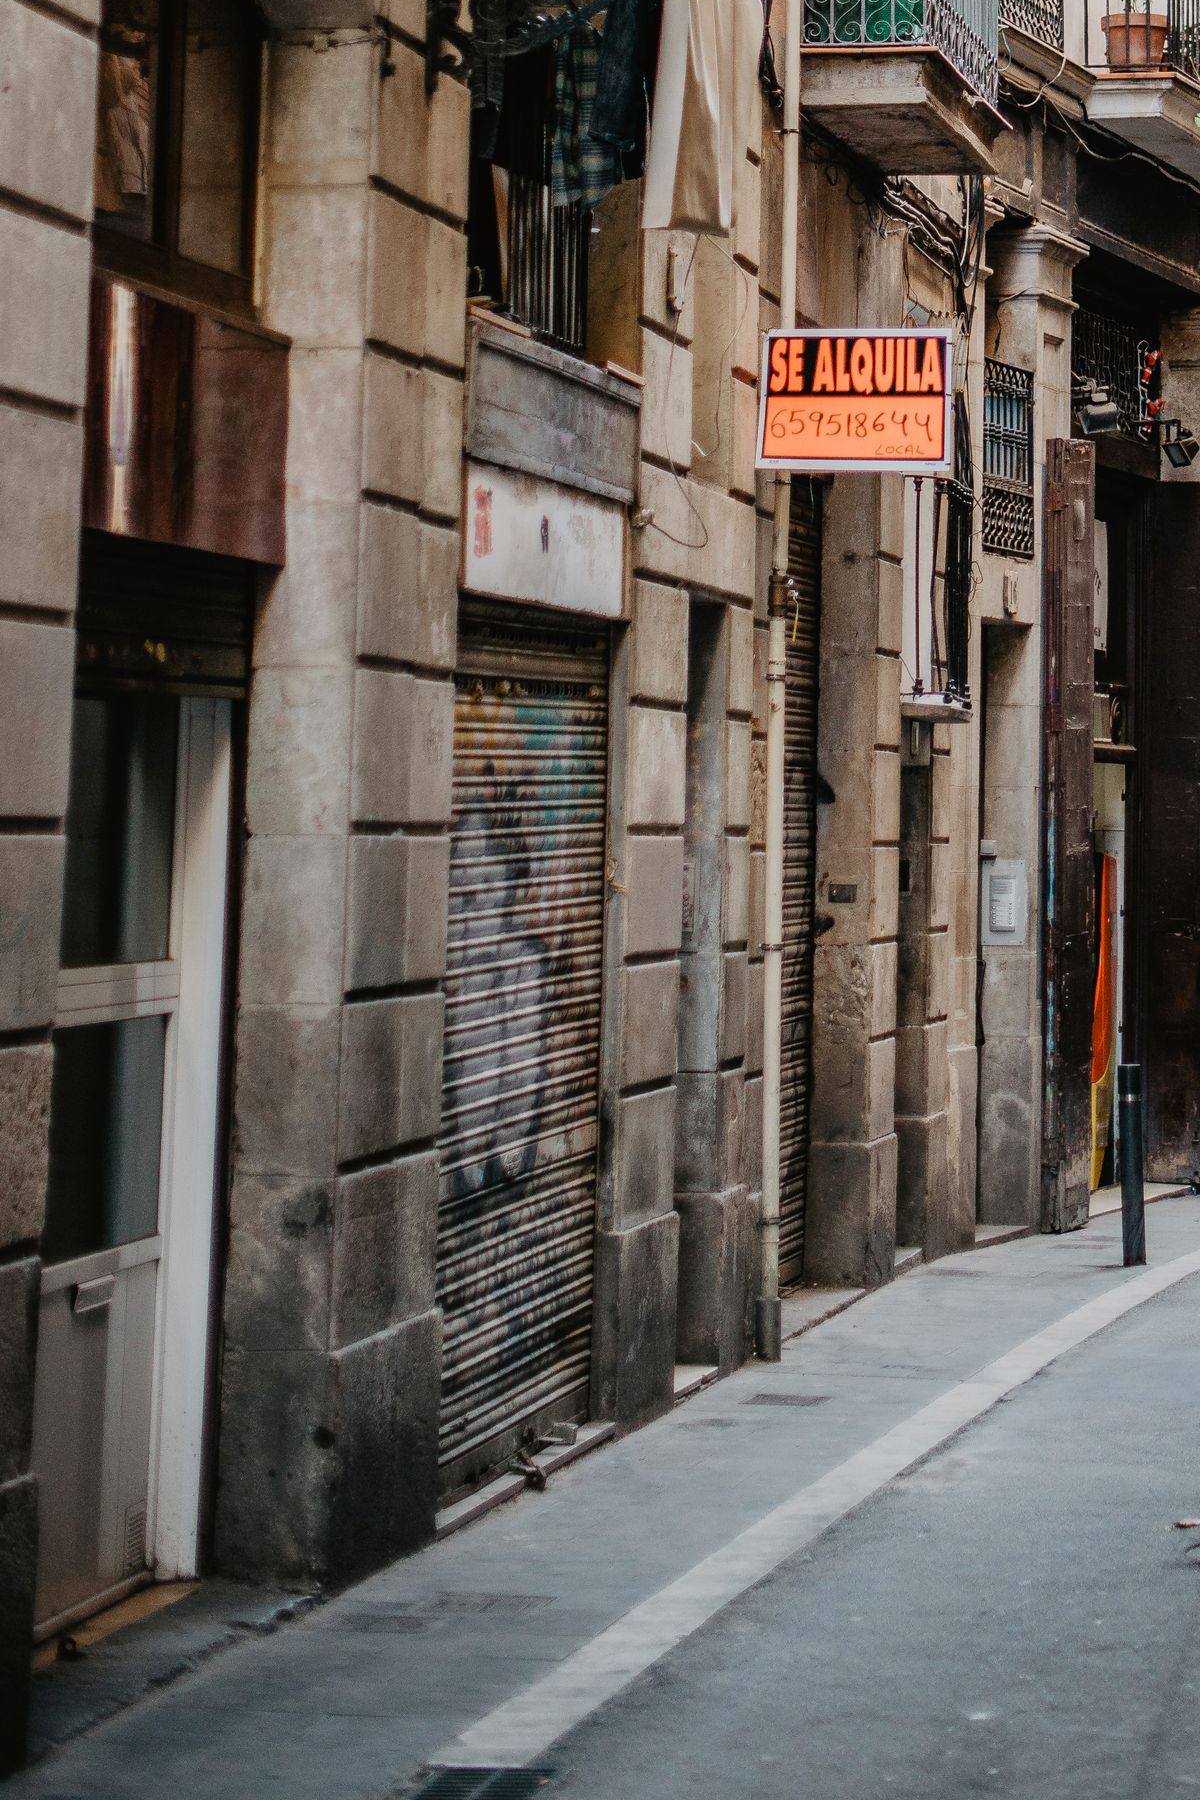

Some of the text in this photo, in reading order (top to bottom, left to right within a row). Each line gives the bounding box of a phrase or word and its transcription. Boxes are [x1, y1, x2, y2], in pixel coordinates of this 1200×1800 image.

[770, 338, 943, 395] SE ALQUILA
[770, 408, 933, 443] 659518644
[874, 444, 926, 456] LOCAL
